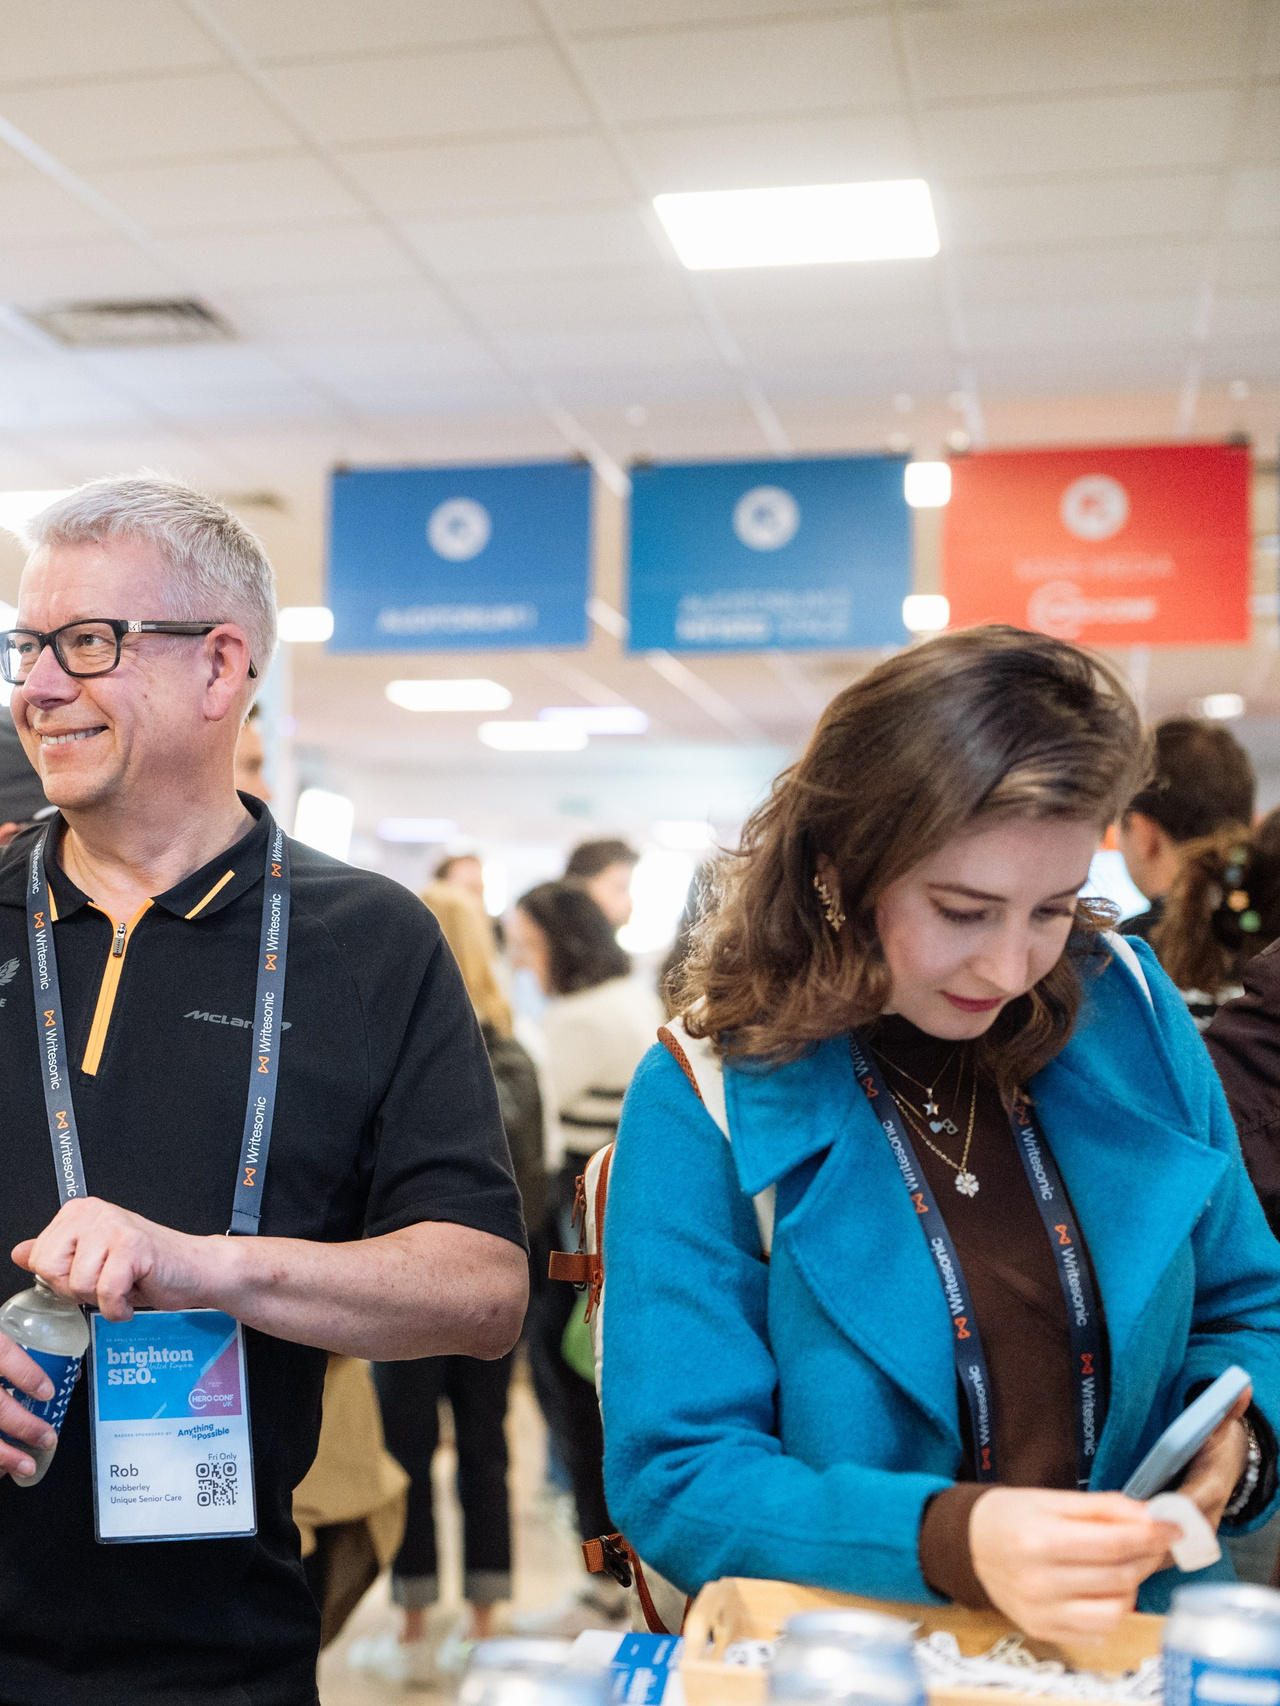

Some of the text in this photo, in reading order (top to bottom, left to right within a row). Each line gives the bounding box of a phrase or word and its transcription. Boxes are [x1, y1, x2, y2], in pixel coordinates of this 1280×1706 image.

[266, 893, 282, 952] Writesonic
[35, 929, 50, 990] Writesonic
[183, 1010, 254, 1029] McLar
[258, 991, 275, 1053] Writesonic
[45, 1027, 60, 1090] Writesonic
[245, 1095, 268, 1165] Writesonic
[882, 1119, 919, 1191] Writesonic
[58, 1130, 78, 1198] Writesonic
[1021, 1127, 1054, 1202] Writesonic
[931, 1236, 966, 1316] Writesonic
[1060, 1246, 1088, 1327] Writesonic
[106, 1346, 194, 1368] brighton
[107, 1367, 157, 1386] SEO.
[191, 1393, 234, 1403] HERO CONF
[1081, 1376, 1096, 1457] Writesonic
[177, 1423, 214, 1437] Anything
[196, 1427, 230, 1441] Possible
[207, 1452, 237, 1461] Fri Only
[109, 1463, 139, 1478] Rob
[109, 1484, 151, 1493] Mobberley
[110, 1494, 183, 1505] Unique Senior Care
